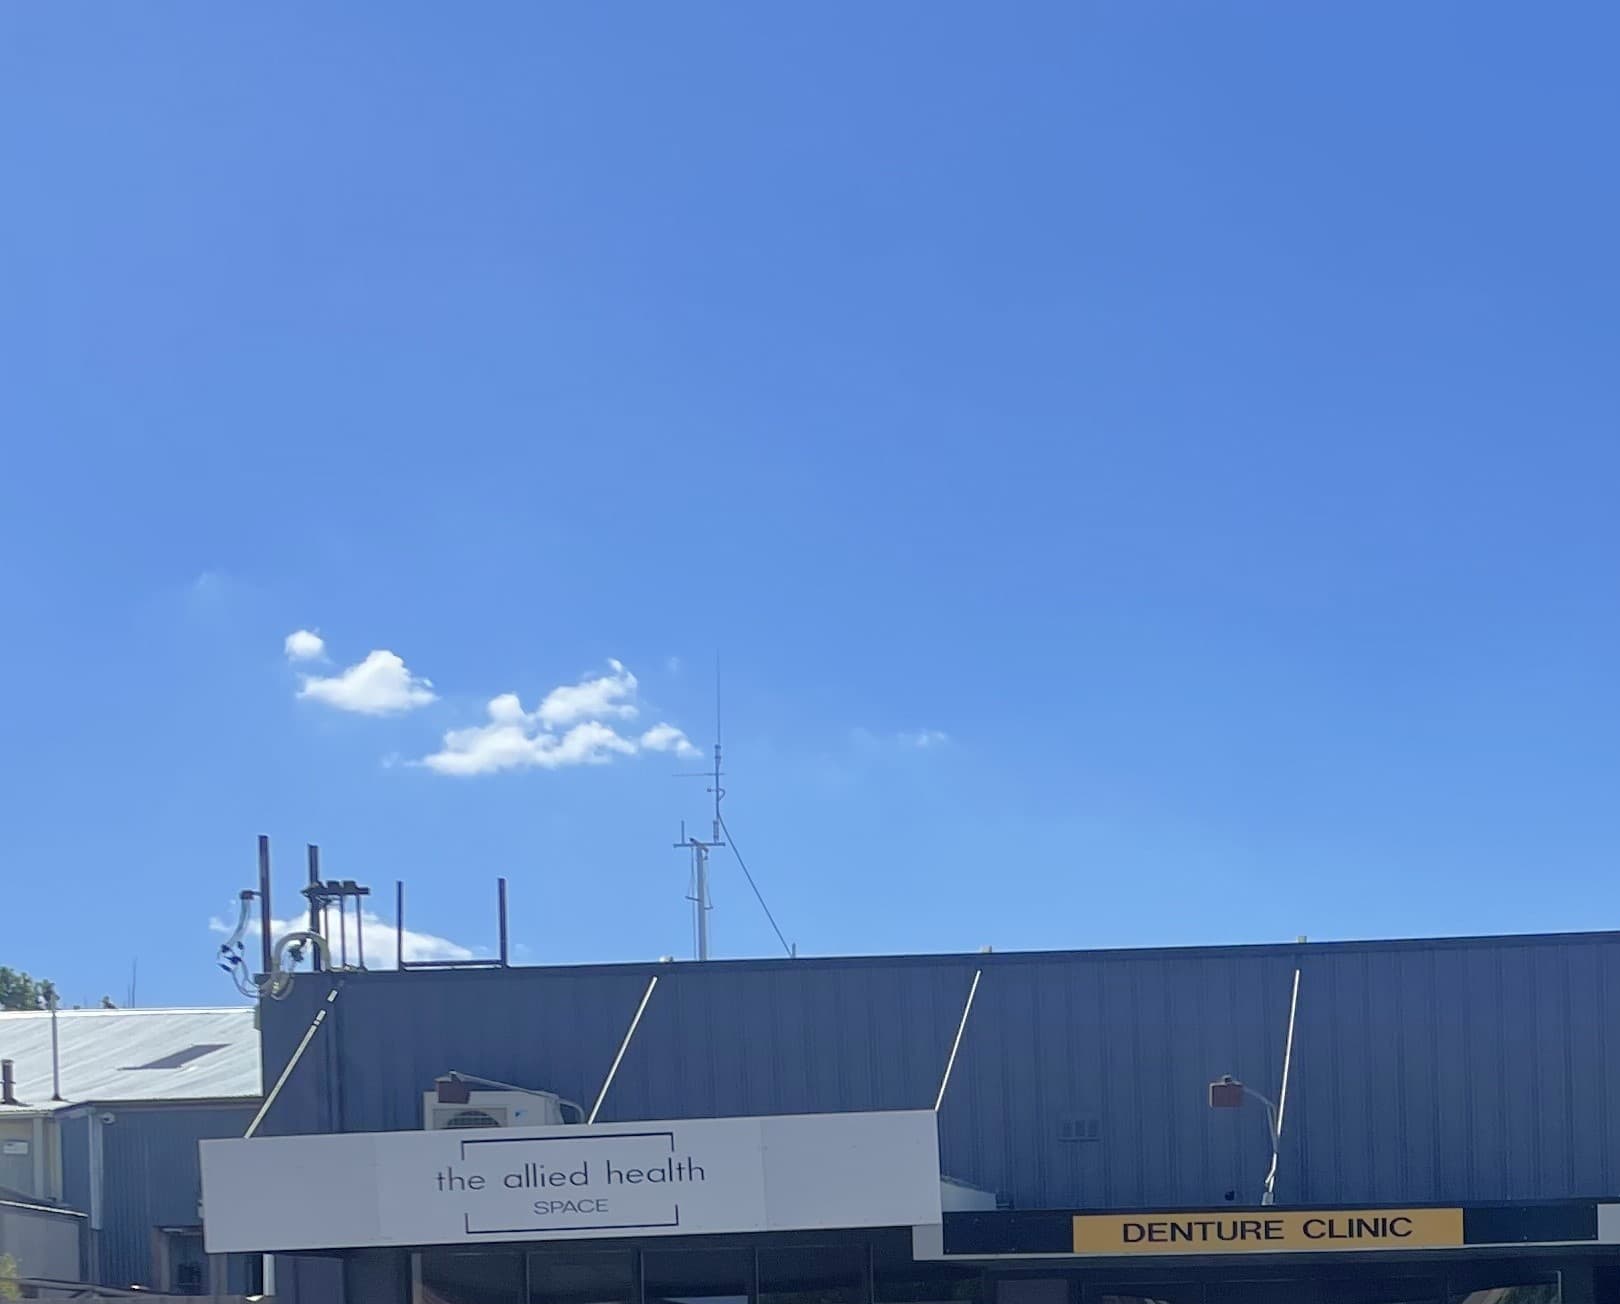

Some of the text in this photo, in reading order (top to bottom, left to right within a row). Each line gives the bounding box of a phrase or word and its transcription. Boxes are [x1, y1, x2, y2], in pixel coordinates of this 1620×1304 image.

[436, 1156, 705, 1191] the allied health
[533, 1199, 609, 1215] SPACE
[1123, 1217, 1413, 1242] DENTURE CLINIC
